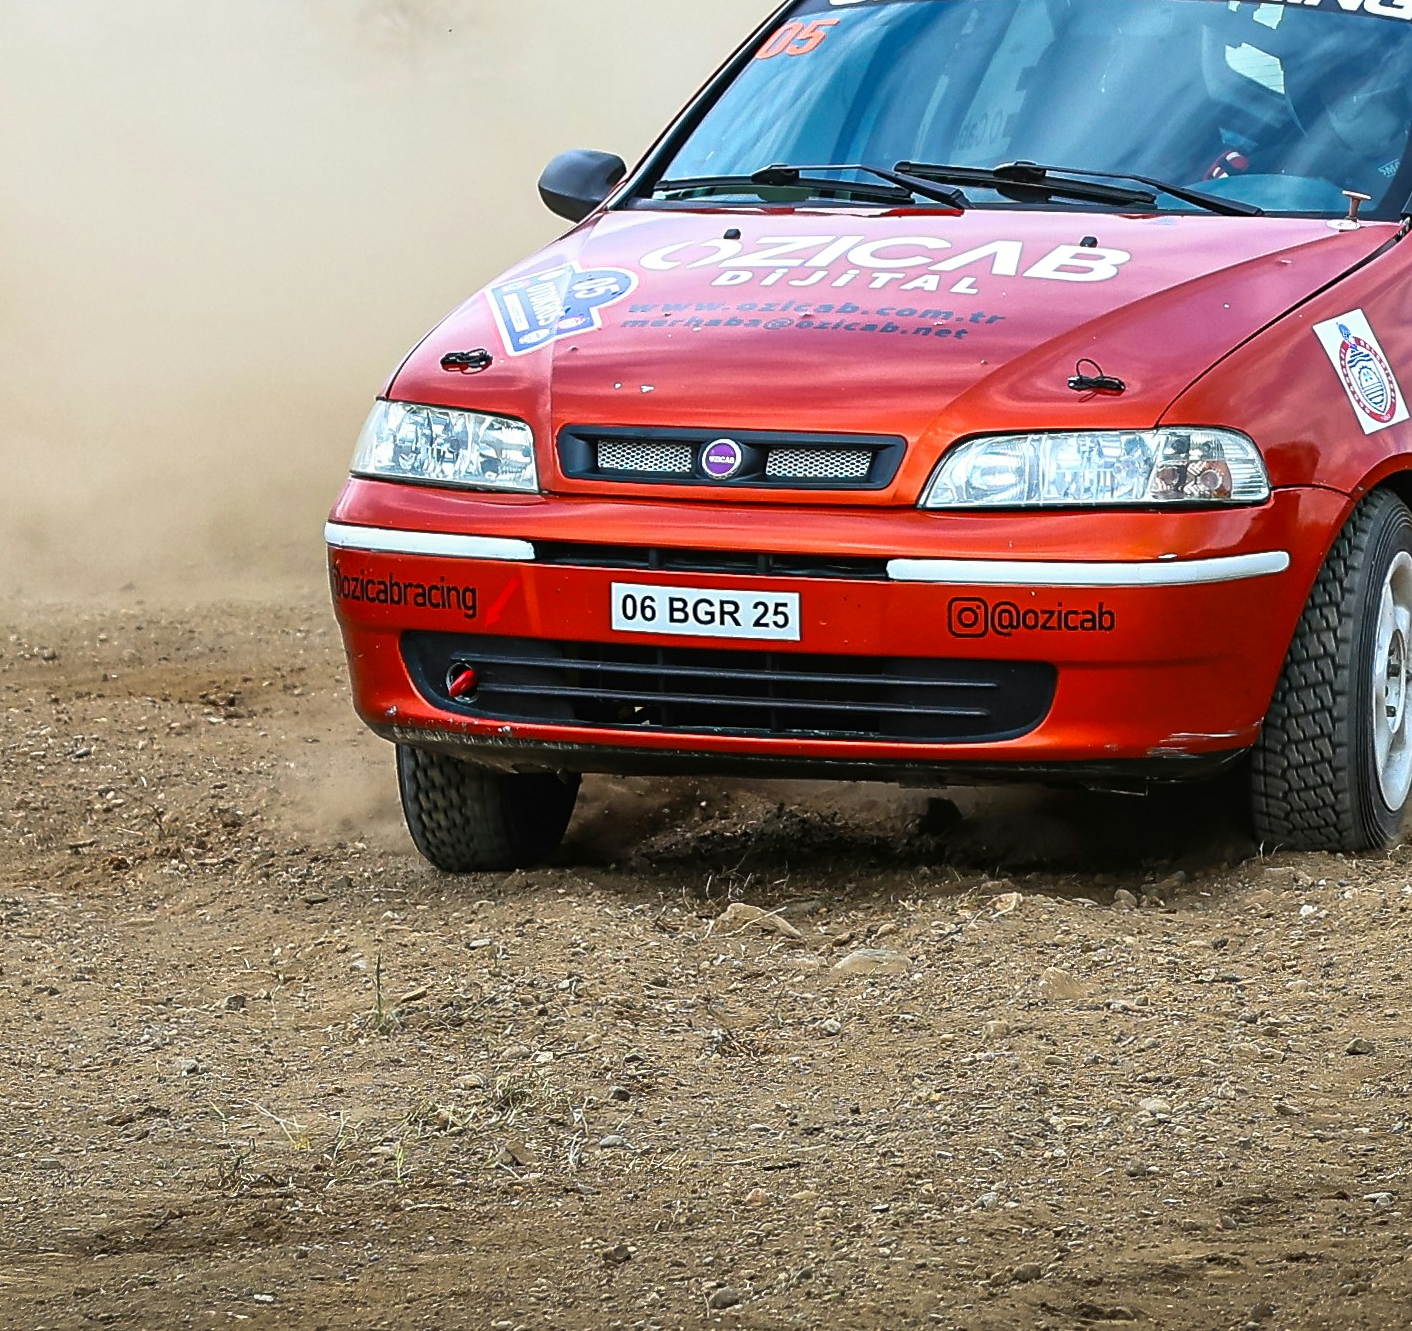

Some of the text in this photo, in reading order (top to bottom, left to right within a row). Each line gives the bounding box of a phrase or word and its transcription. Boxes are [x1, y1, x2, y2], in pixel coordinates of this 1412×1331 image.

[755, 18, 841, 60] 05
[638, 235, 1132, 282] OZICAB
[620, 316, 969, 340] merhaba@ozicab.net
[629, 300, 1006, 325] www.ozicab.com.tr
[620, 593, 790, 629] 06 BGR 25
[990, 601, 1116, 637] @ozicab
